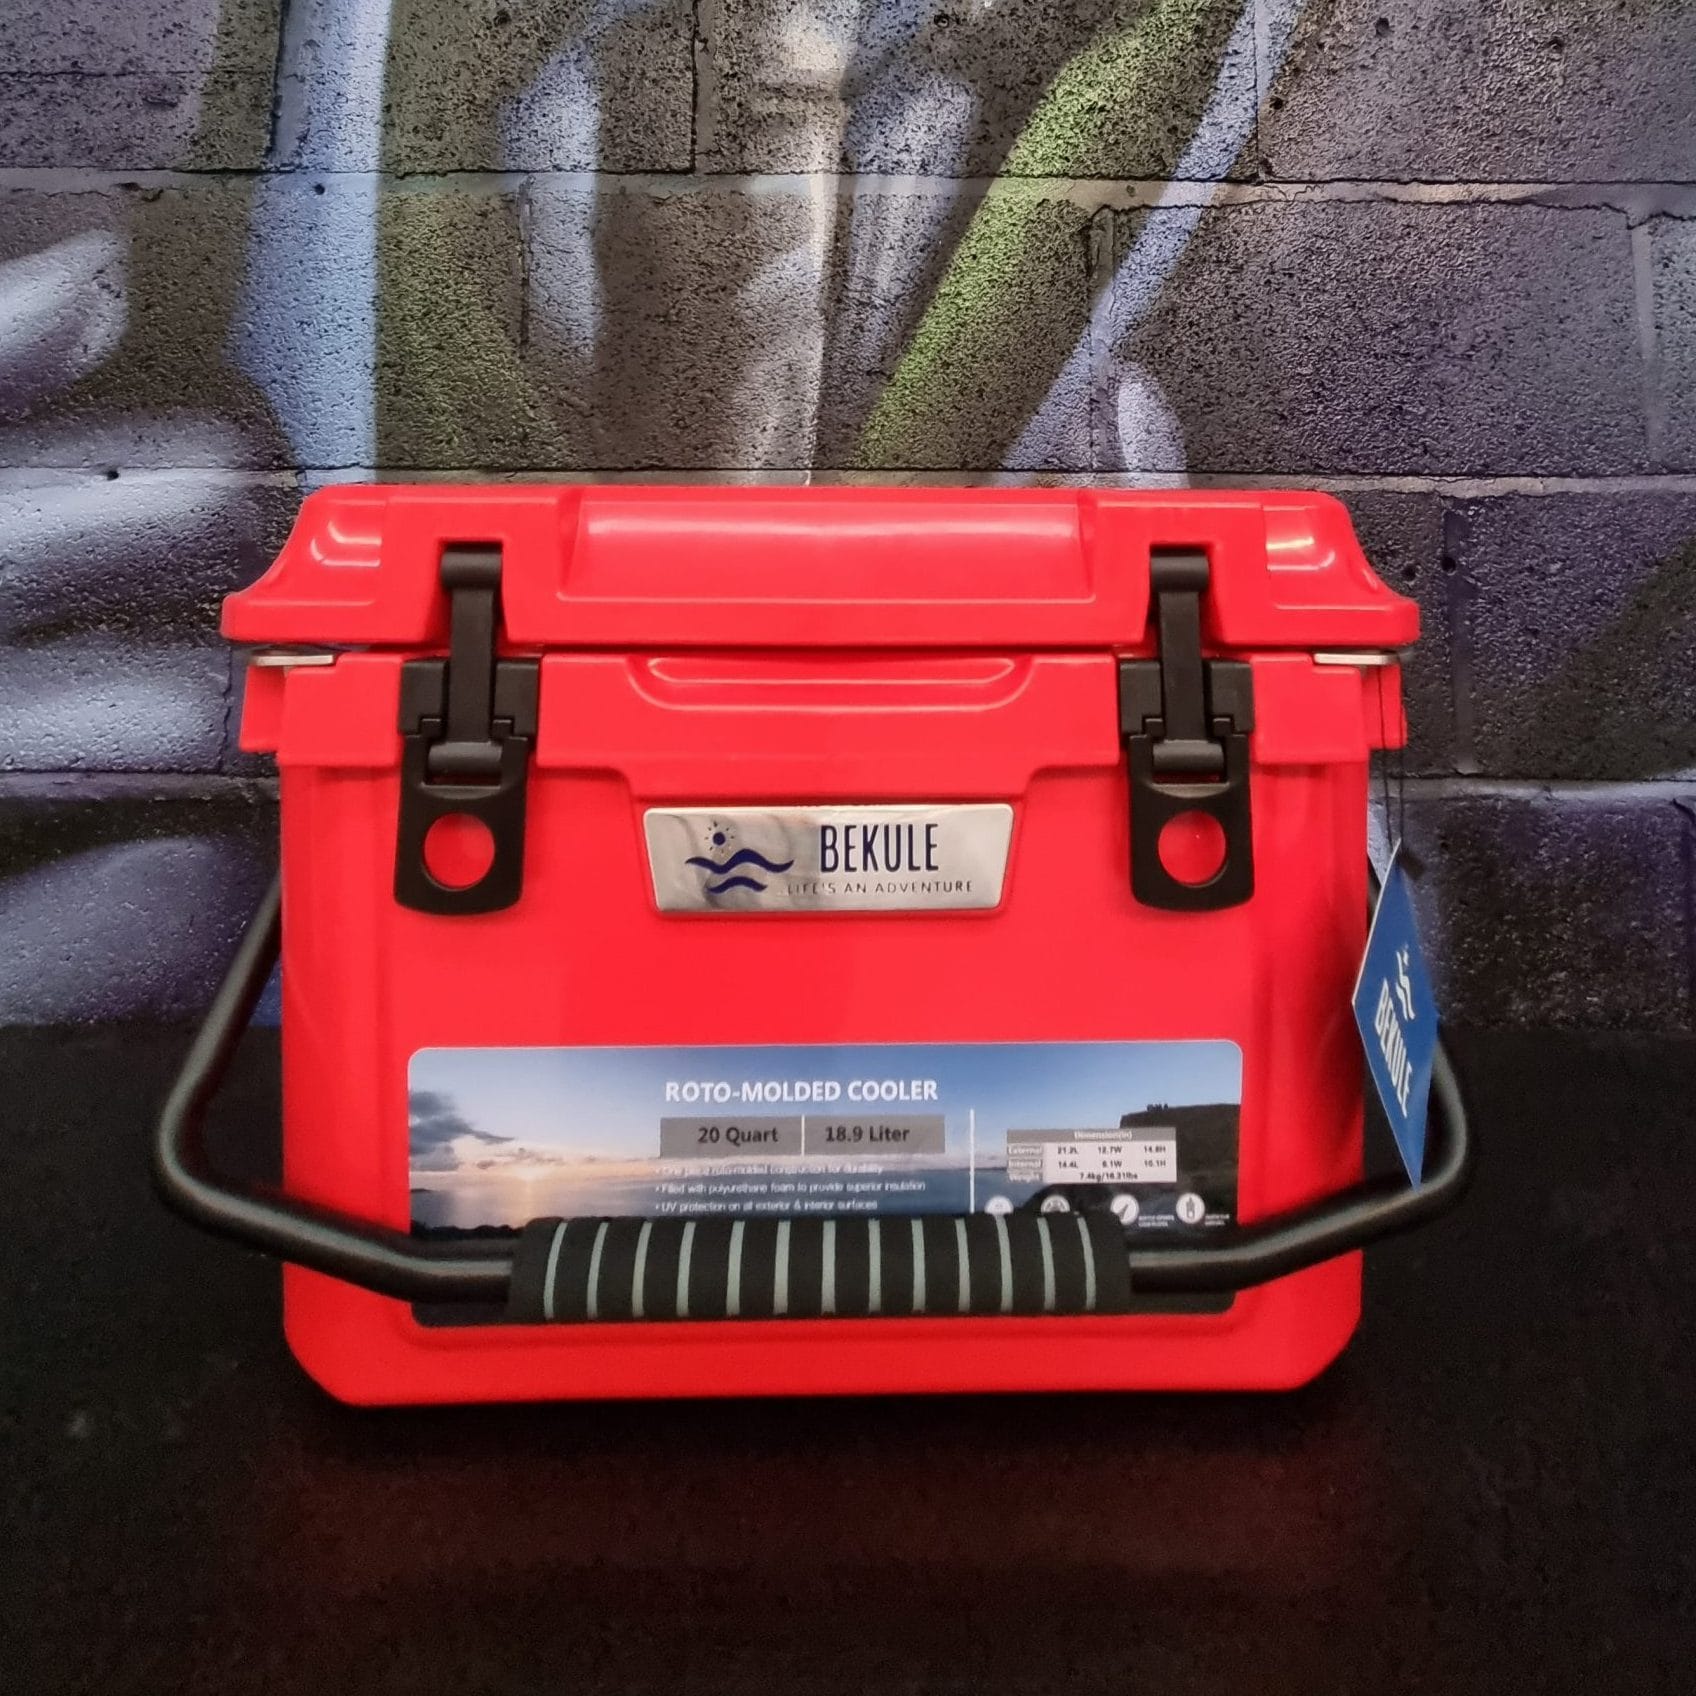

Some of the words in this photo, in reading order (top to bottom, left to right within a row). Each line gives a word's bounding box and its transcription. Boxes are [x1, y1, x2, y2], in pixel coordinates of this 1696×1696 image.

[820, 823, 939, 873] BEKULE
[787, 882, 836, 895] LIFE'S
[844, 881, 867, 894] AN
[875, 880, 973, 894] ADVENTURE
[665, 1081, 841, 1103] ROTO-MOLDED
[848, 1080, 939, 1102] COOLER
[698, 1127, 720, 1143] 20
[725, 1127, 778, 1146] Quart
[825, 1126, 863, 1142] 18.9
[869, 1125, 910, 1142] Liter
